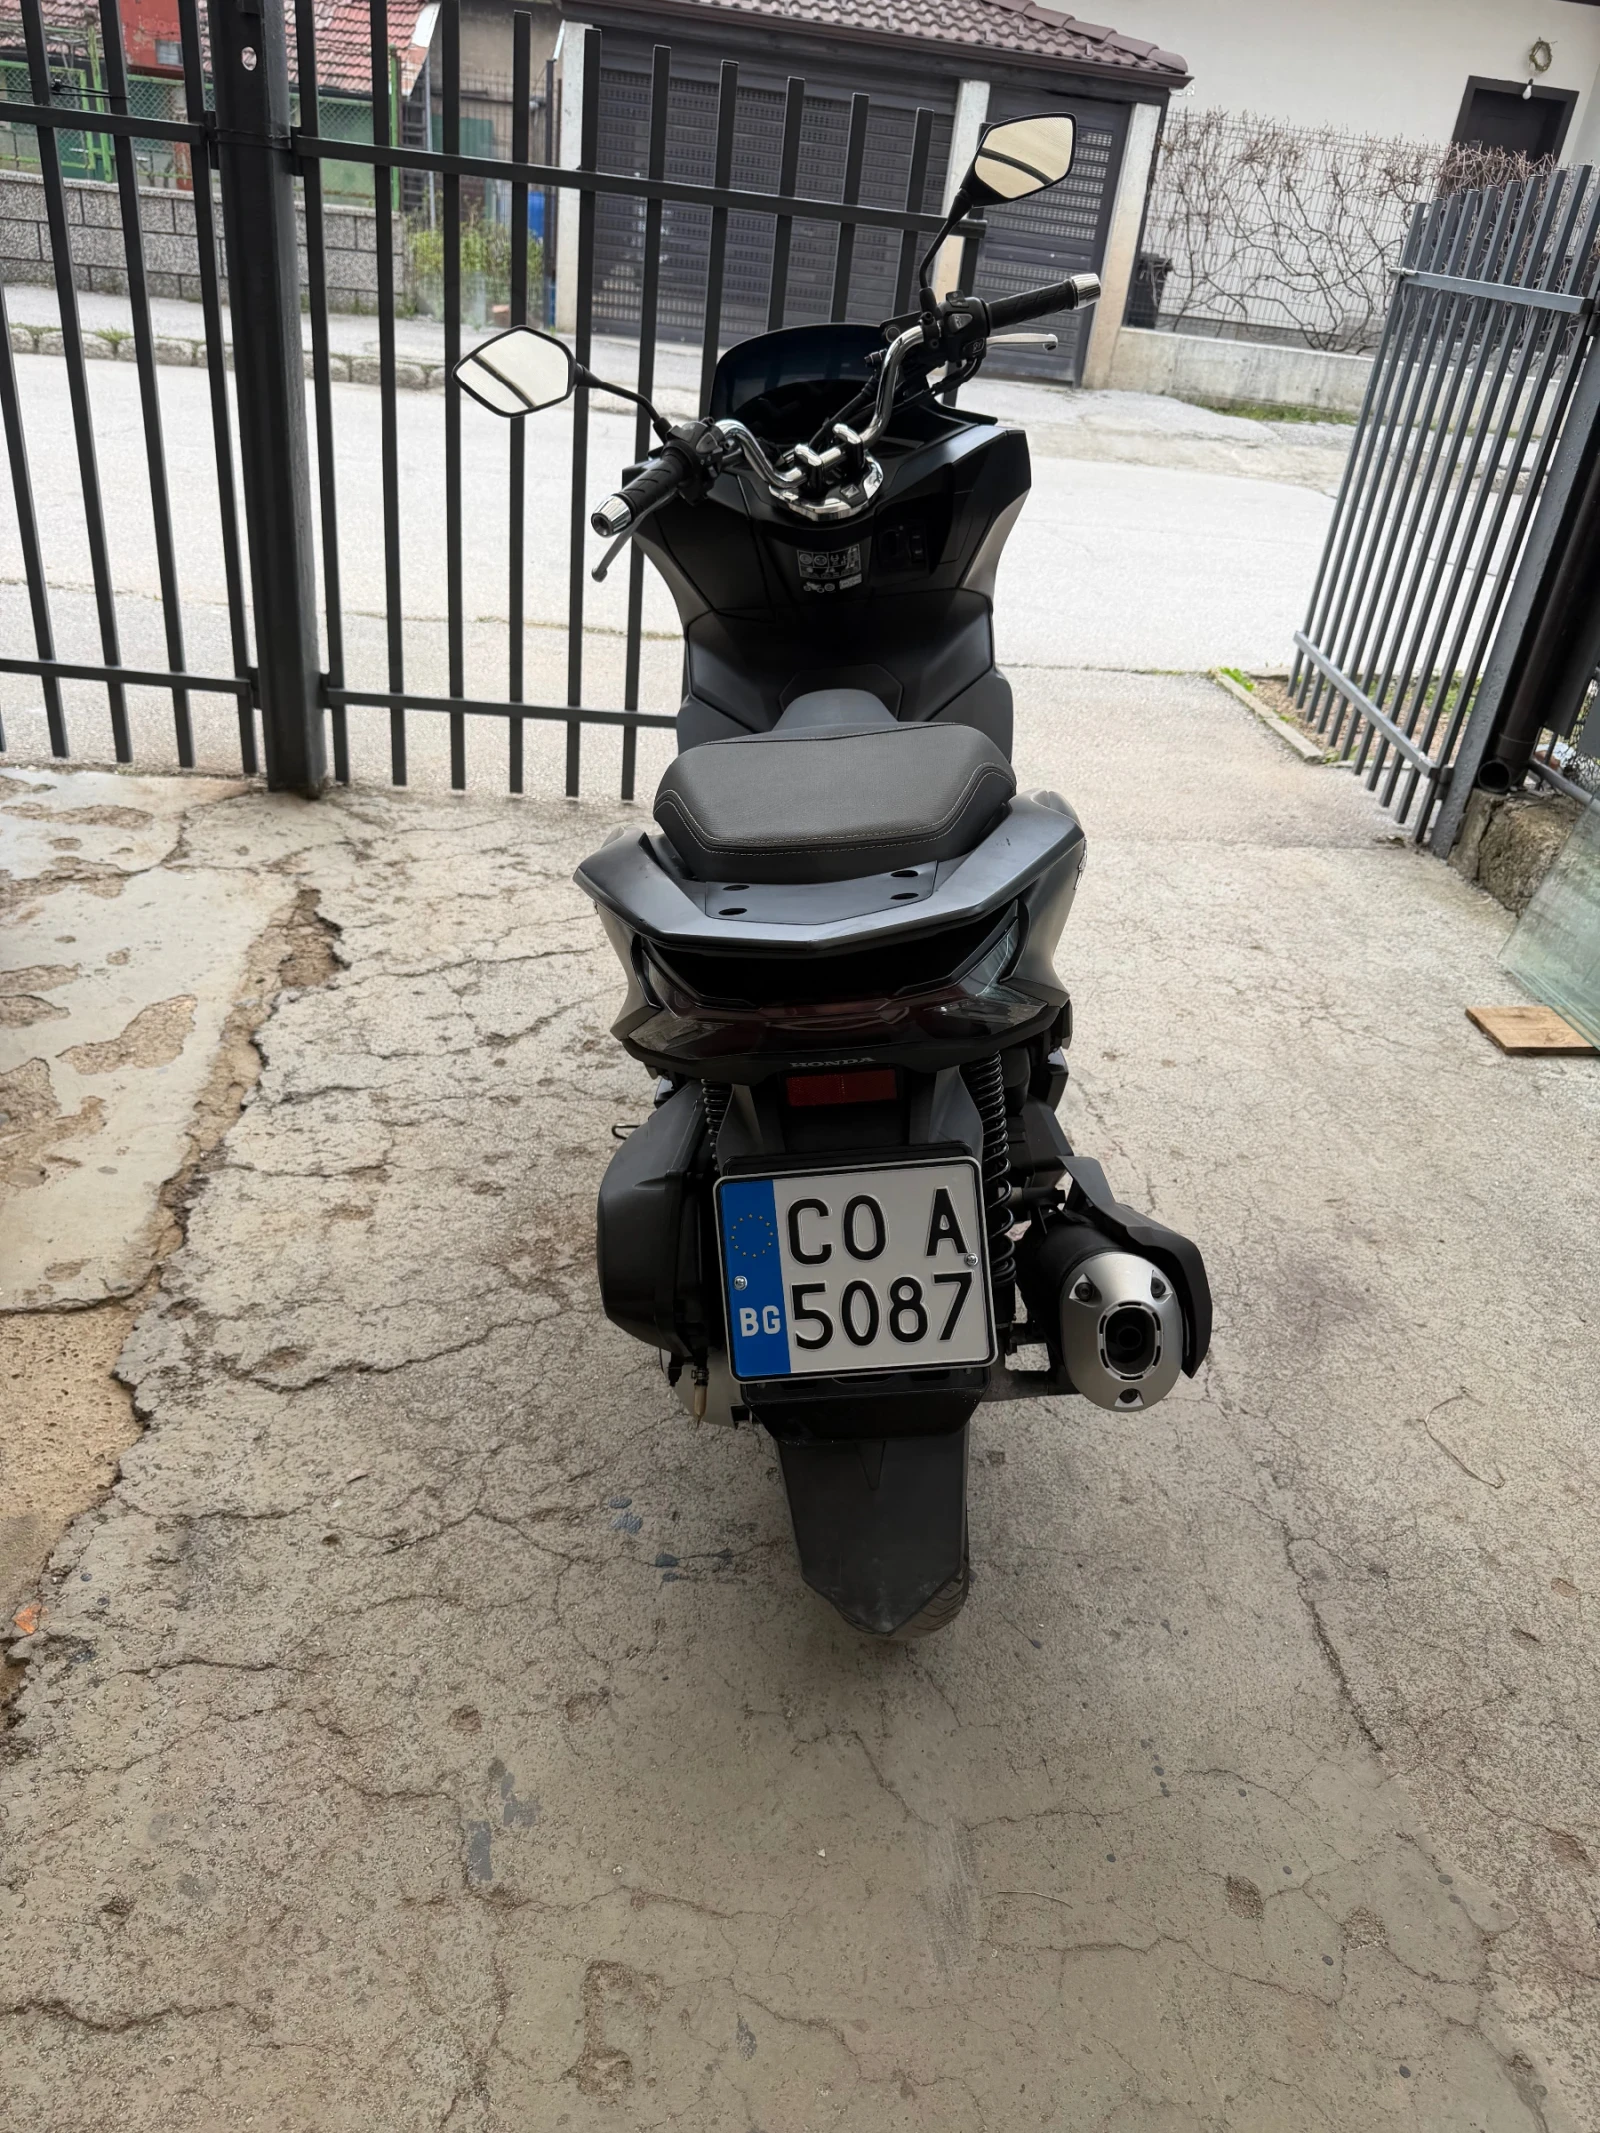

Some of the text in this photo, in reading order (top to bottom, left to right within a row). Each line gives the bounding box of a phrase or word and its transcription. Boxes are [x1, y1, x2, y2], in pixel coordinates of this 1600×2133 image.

[788, 1057, 877, 1068] HONDA
[787, 1187, 970, 1266] CO A
[739, 1305, 782, 1337] BG
[791, 1271, 973, 1351] 5087
